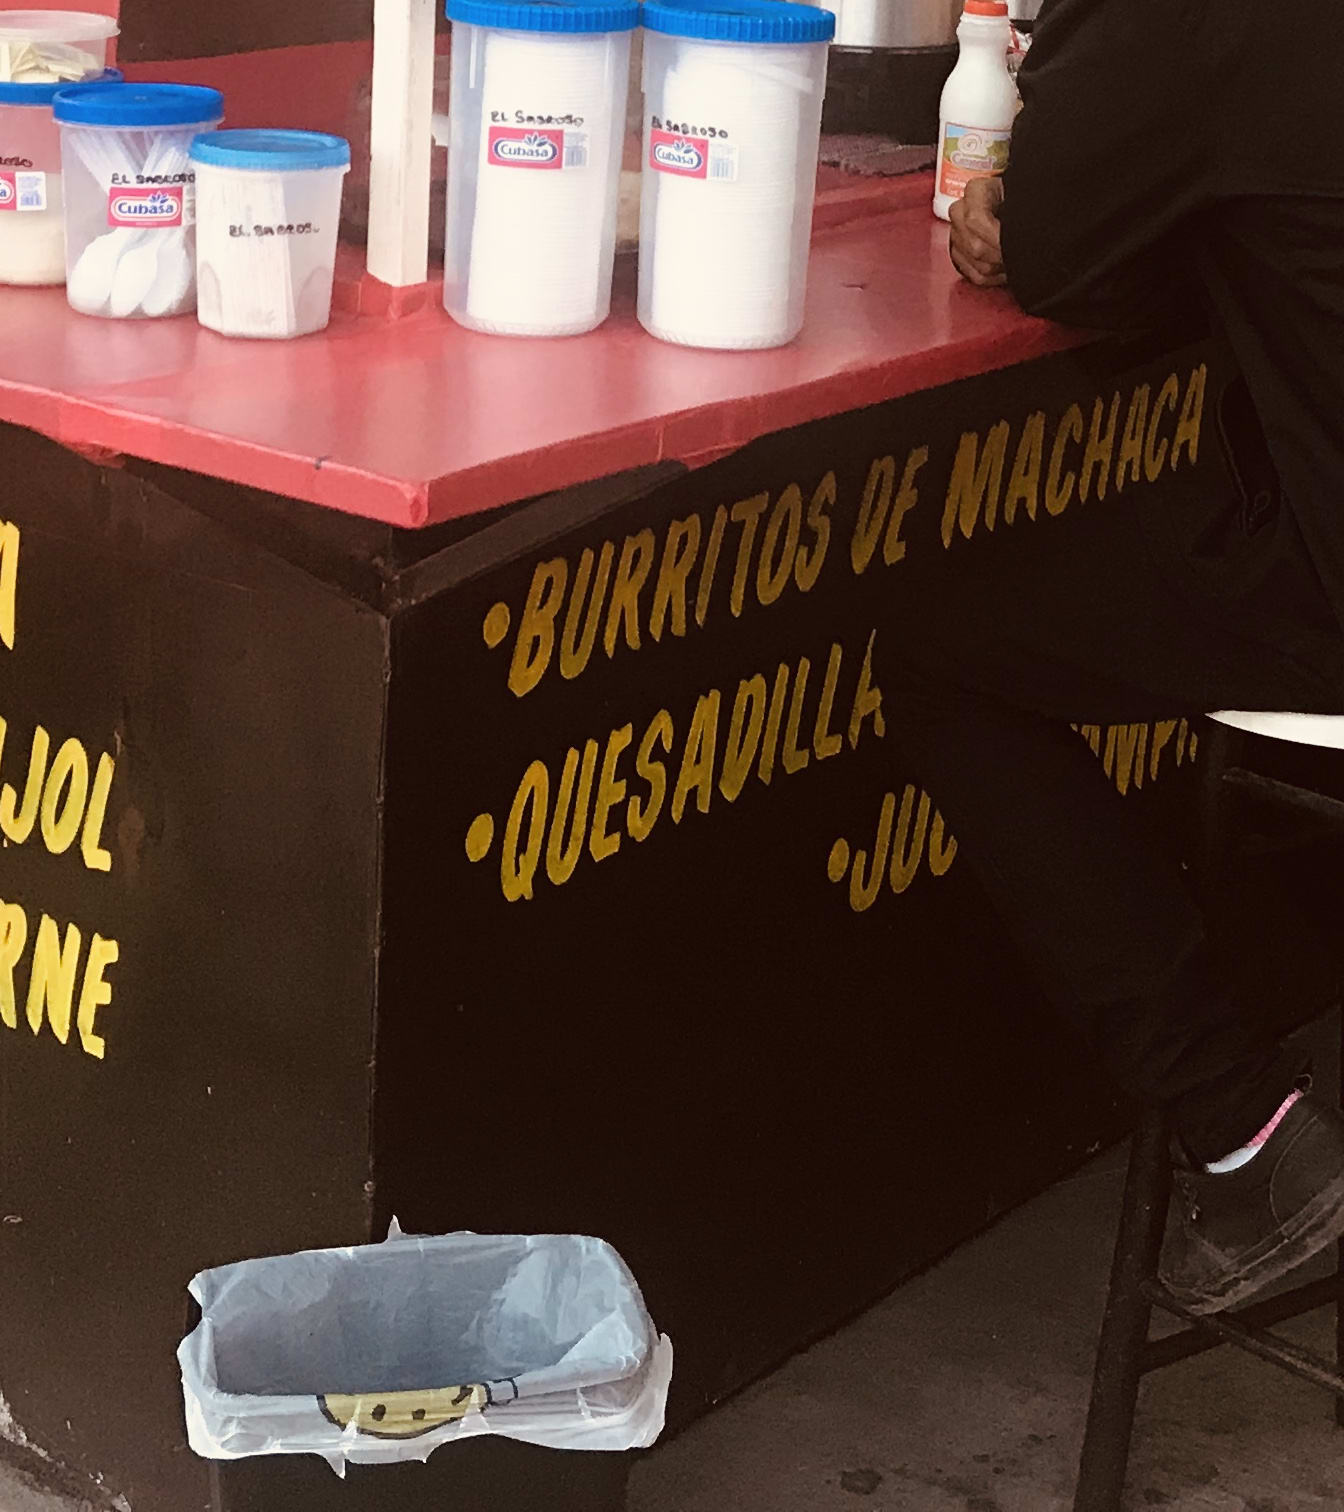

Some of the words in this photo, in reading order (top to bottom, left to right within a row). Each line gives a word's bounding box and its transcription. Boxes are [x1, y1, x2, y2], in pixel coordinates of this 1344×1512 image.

[500, 142, 549, 158] Cubasa
[656, 147, 694, 166] Cubasa
[118, 201, 174, 216] Cubasa
[506, 469, 837, 699] BURRITOS
[849, 444, 929, 578] DE
[940, 362, 1209, 550] MACHACA
